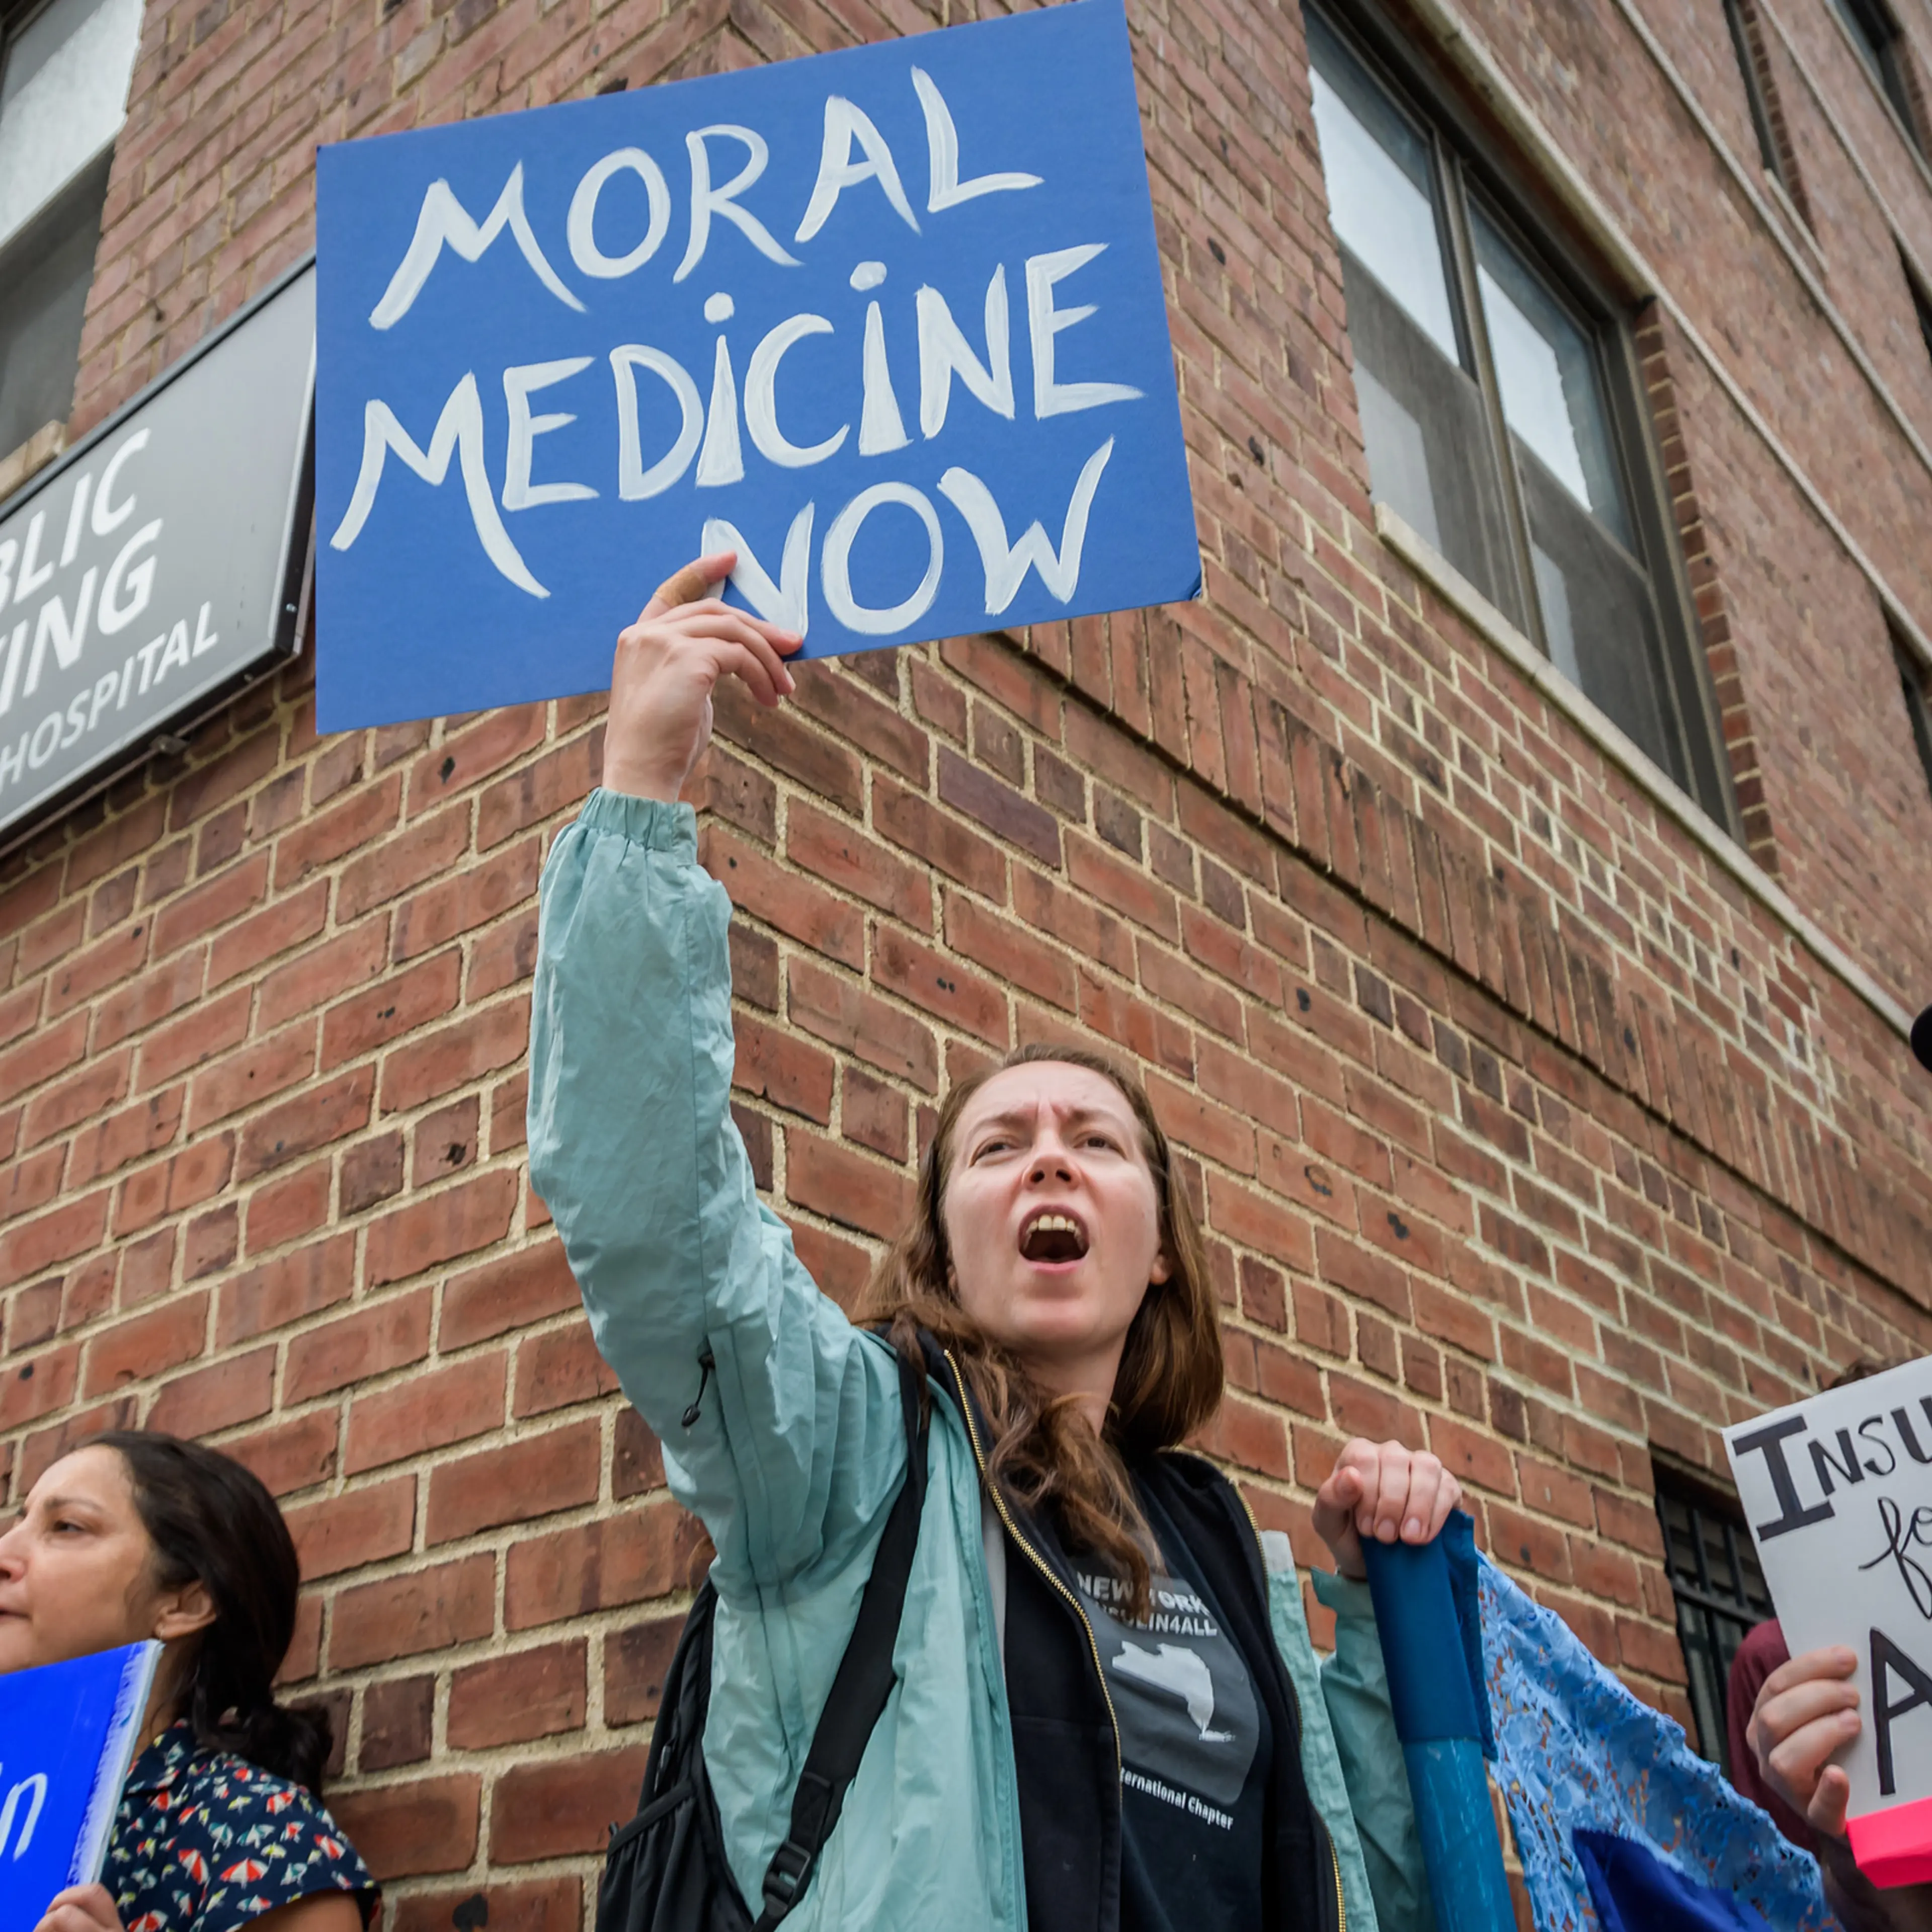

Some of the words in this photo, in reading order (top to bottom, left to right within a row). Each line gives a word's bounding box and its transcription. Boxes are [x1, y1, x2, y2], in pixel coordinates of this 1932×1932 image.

[368, 66, 1044, 330] MORAL
[0, 518, 164, 716] ING
[701, 436, 1114, 642] NOW
[0, 600, 219, 794] HOSPITAL
[1077, 1571, 1135, 1603] NEW
[1095, 1601, 1218, 1637] LIN4ALL
[1187, 1796, 1234, 1831] Chapter
